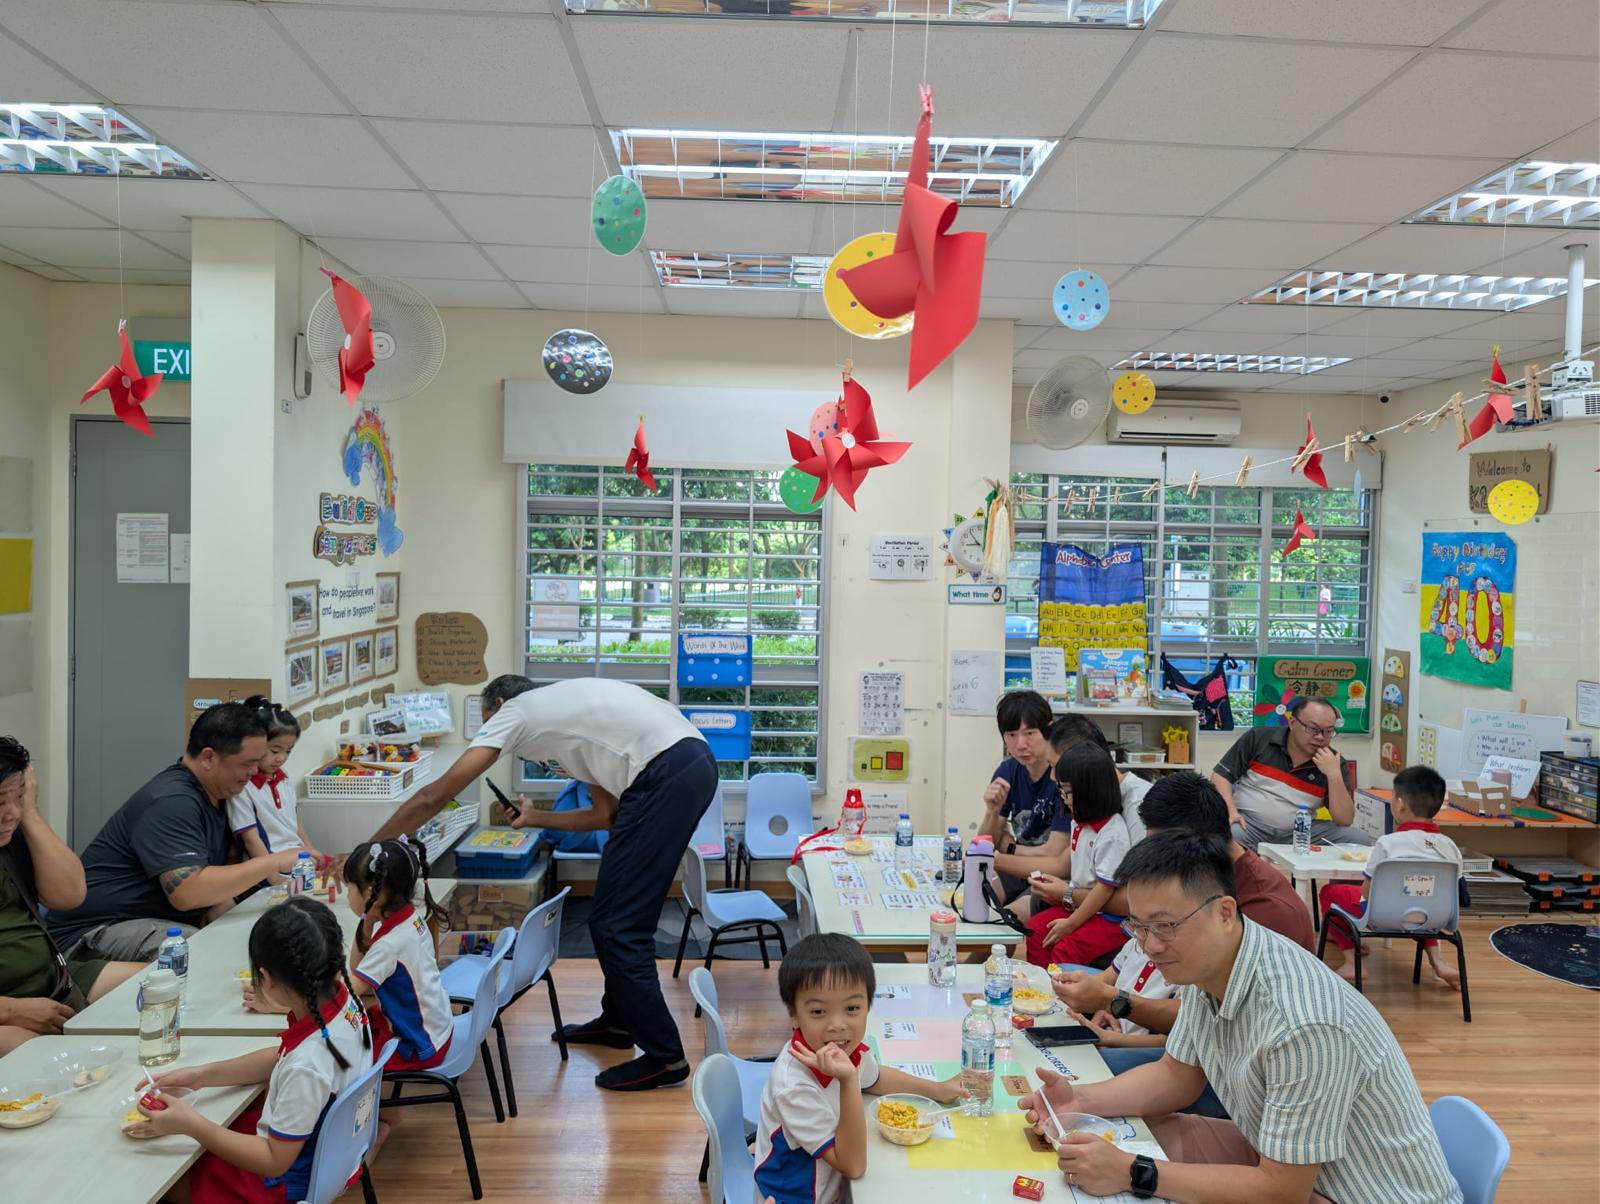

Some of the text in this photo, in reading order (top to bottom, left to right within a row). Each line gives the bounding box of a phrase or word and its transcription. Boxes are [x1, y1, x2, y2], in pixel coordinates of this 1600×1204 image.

[153, 348, 191, 375] EXI
[322, 496, 355, 521] Build
[322, 604, 332, 616] and
[352, 602, 376, 618] Singapore?
[1429, 575, 1505, 665] 40
[1279, 661, 1355, 678] Calm Corner
[1482, 735, 1497, 743] What
[1489, 759, 1505, 769] What
